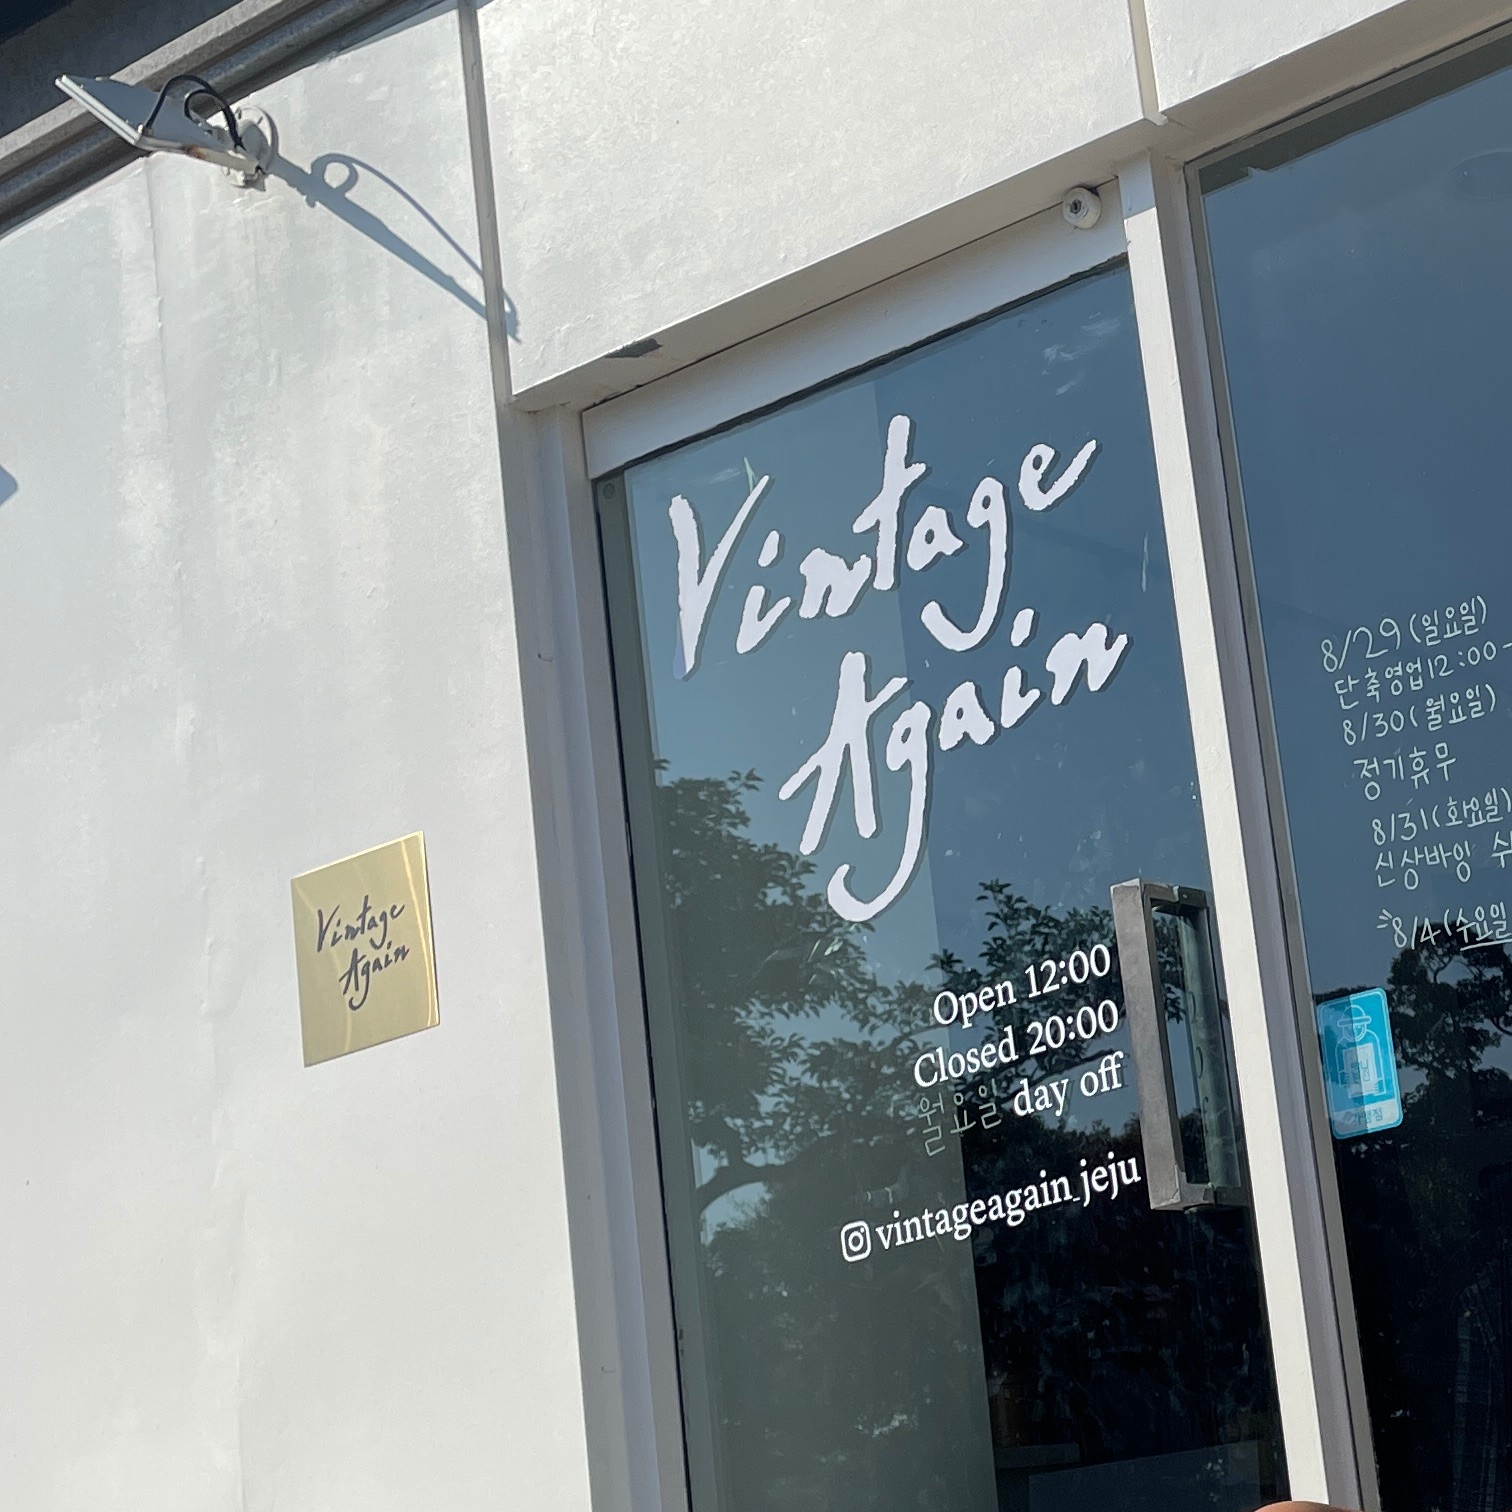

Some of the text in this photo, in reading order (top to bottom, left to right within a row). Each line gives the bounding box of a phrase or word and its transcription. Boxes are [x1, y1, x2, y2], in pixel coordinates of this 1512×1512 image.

[668, 414, 1097, 676] Vintage
[779, 607, 1129, 922] Again
[1353, 742, 1457, 801] 정기휴무
[316, 894, 405, 953] Vintage
[338, 940, 410, 1011] Again
[933, 943, 1111, 1029] Open 12:00
[914, 999, 1119, 1089] Closed 20:00
[918, 1050, 1124, 1157] 월요일 day off
